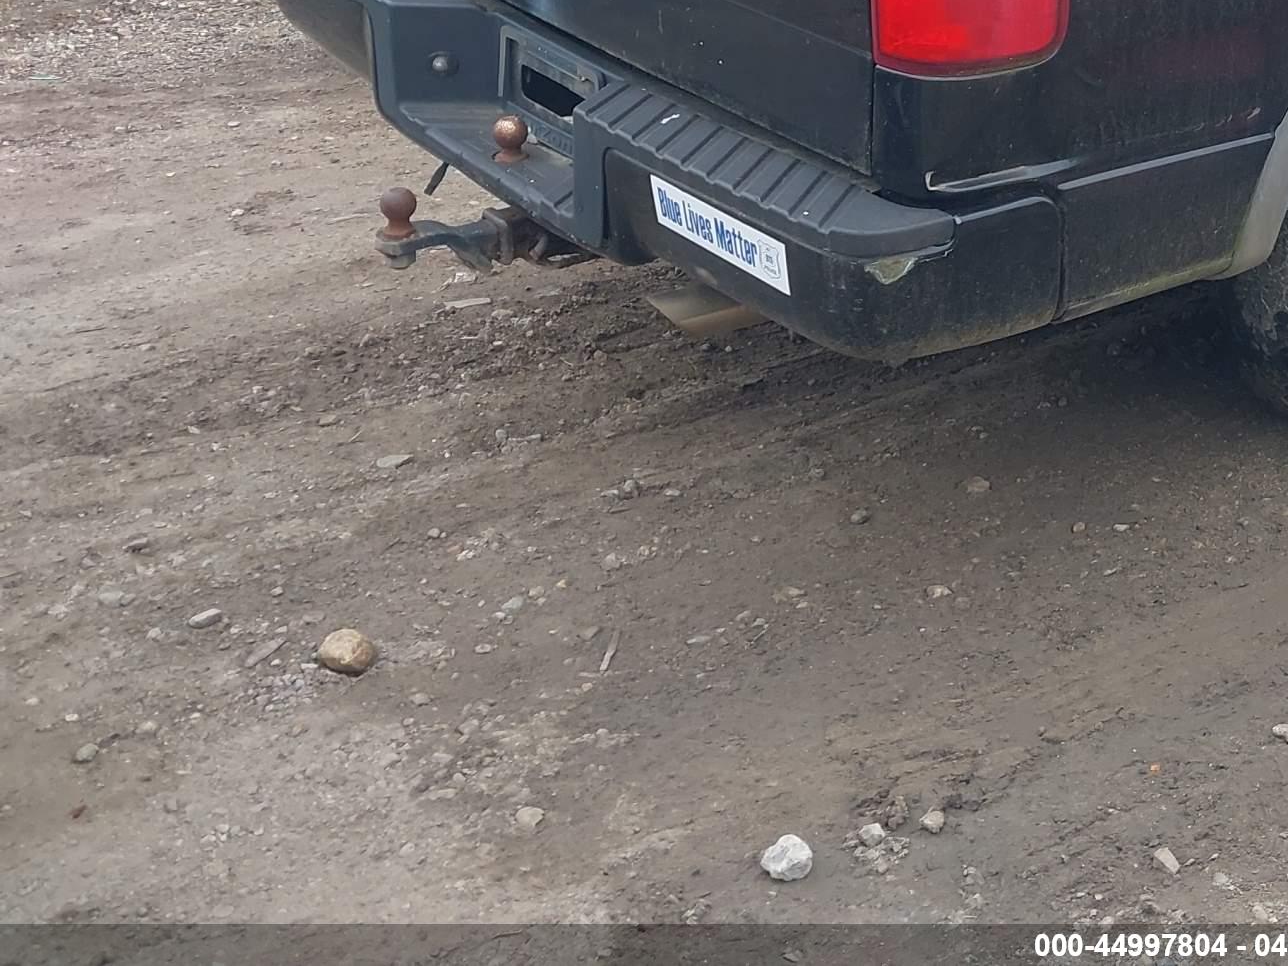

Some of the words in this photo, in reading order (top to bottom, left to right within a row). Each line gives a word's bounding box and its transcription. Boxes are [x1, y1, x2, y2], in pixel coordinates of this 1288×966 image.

[657, 186, 683, 227] Blue
[682, 200, 714, 244] Lives
[713, 217, 758, 268] Matter
